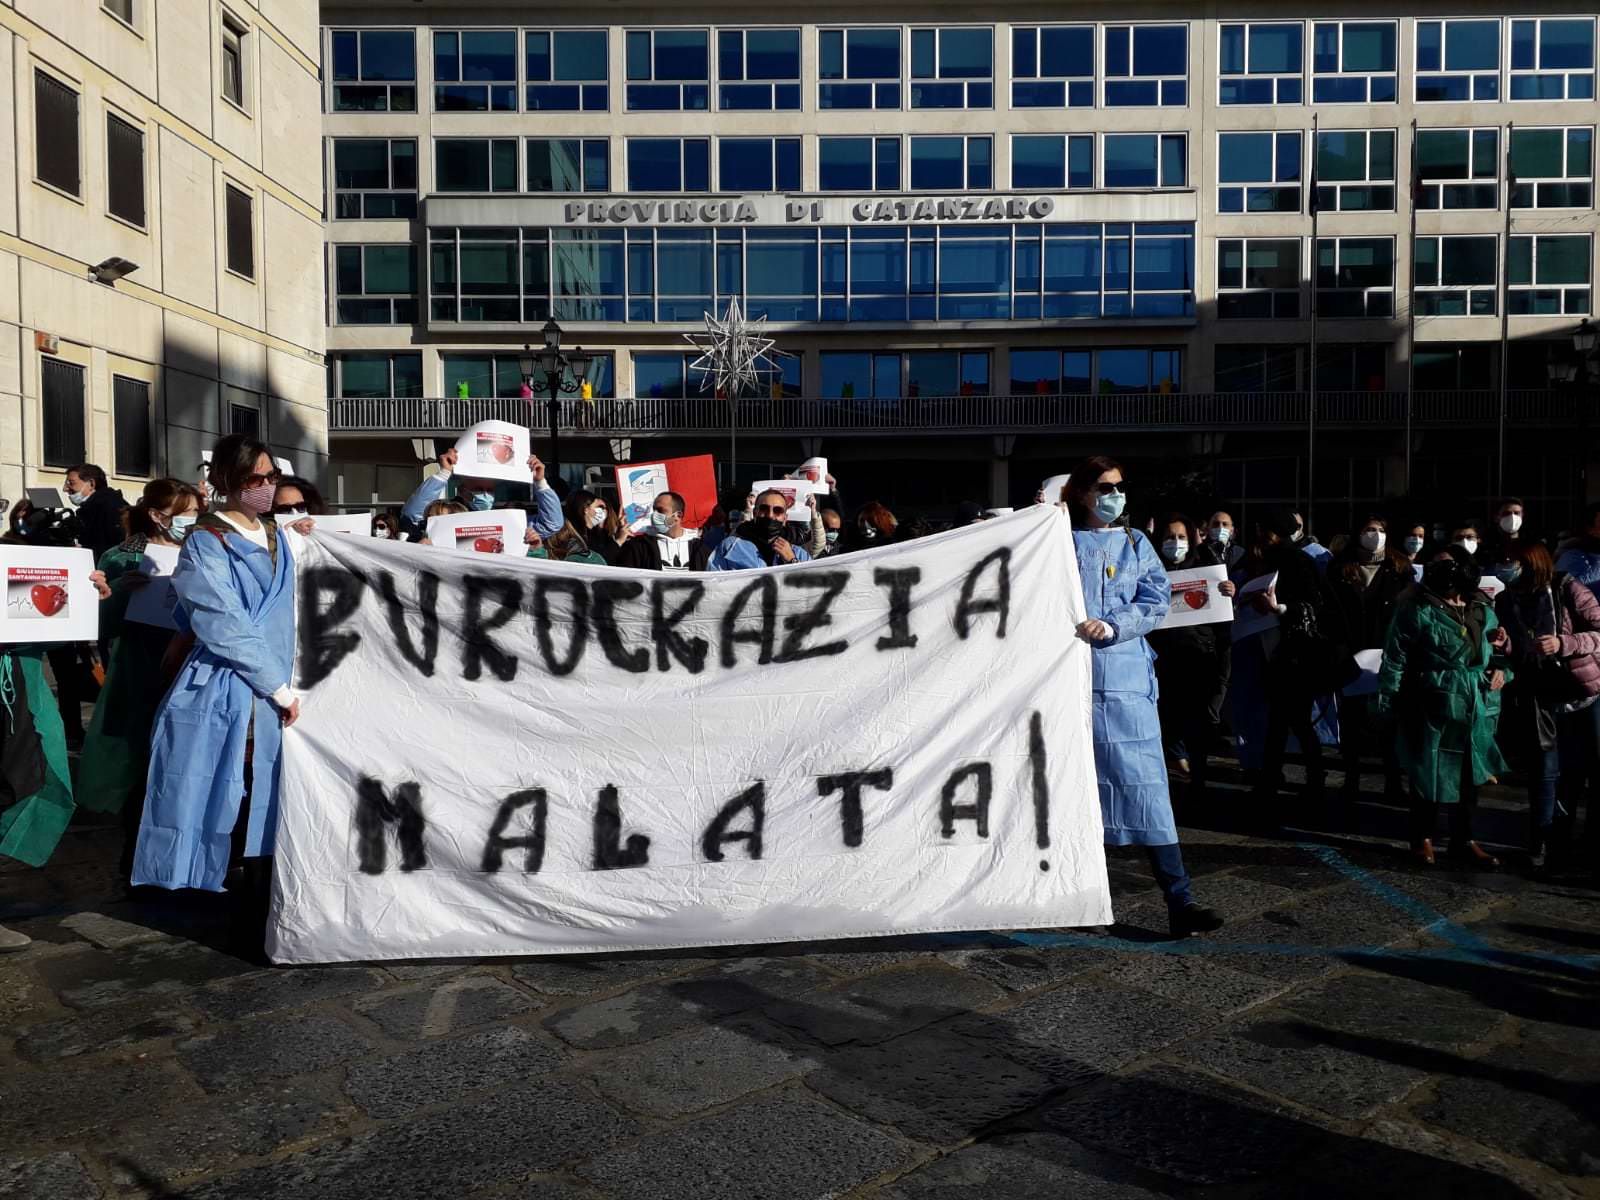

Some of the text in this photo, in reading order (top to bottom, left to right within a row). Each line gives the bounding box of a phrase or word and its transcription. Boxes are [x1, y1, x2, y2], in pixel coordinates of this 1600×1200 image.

[564, 196, 1055, 223] PROVINCIA DI CATANZARO
